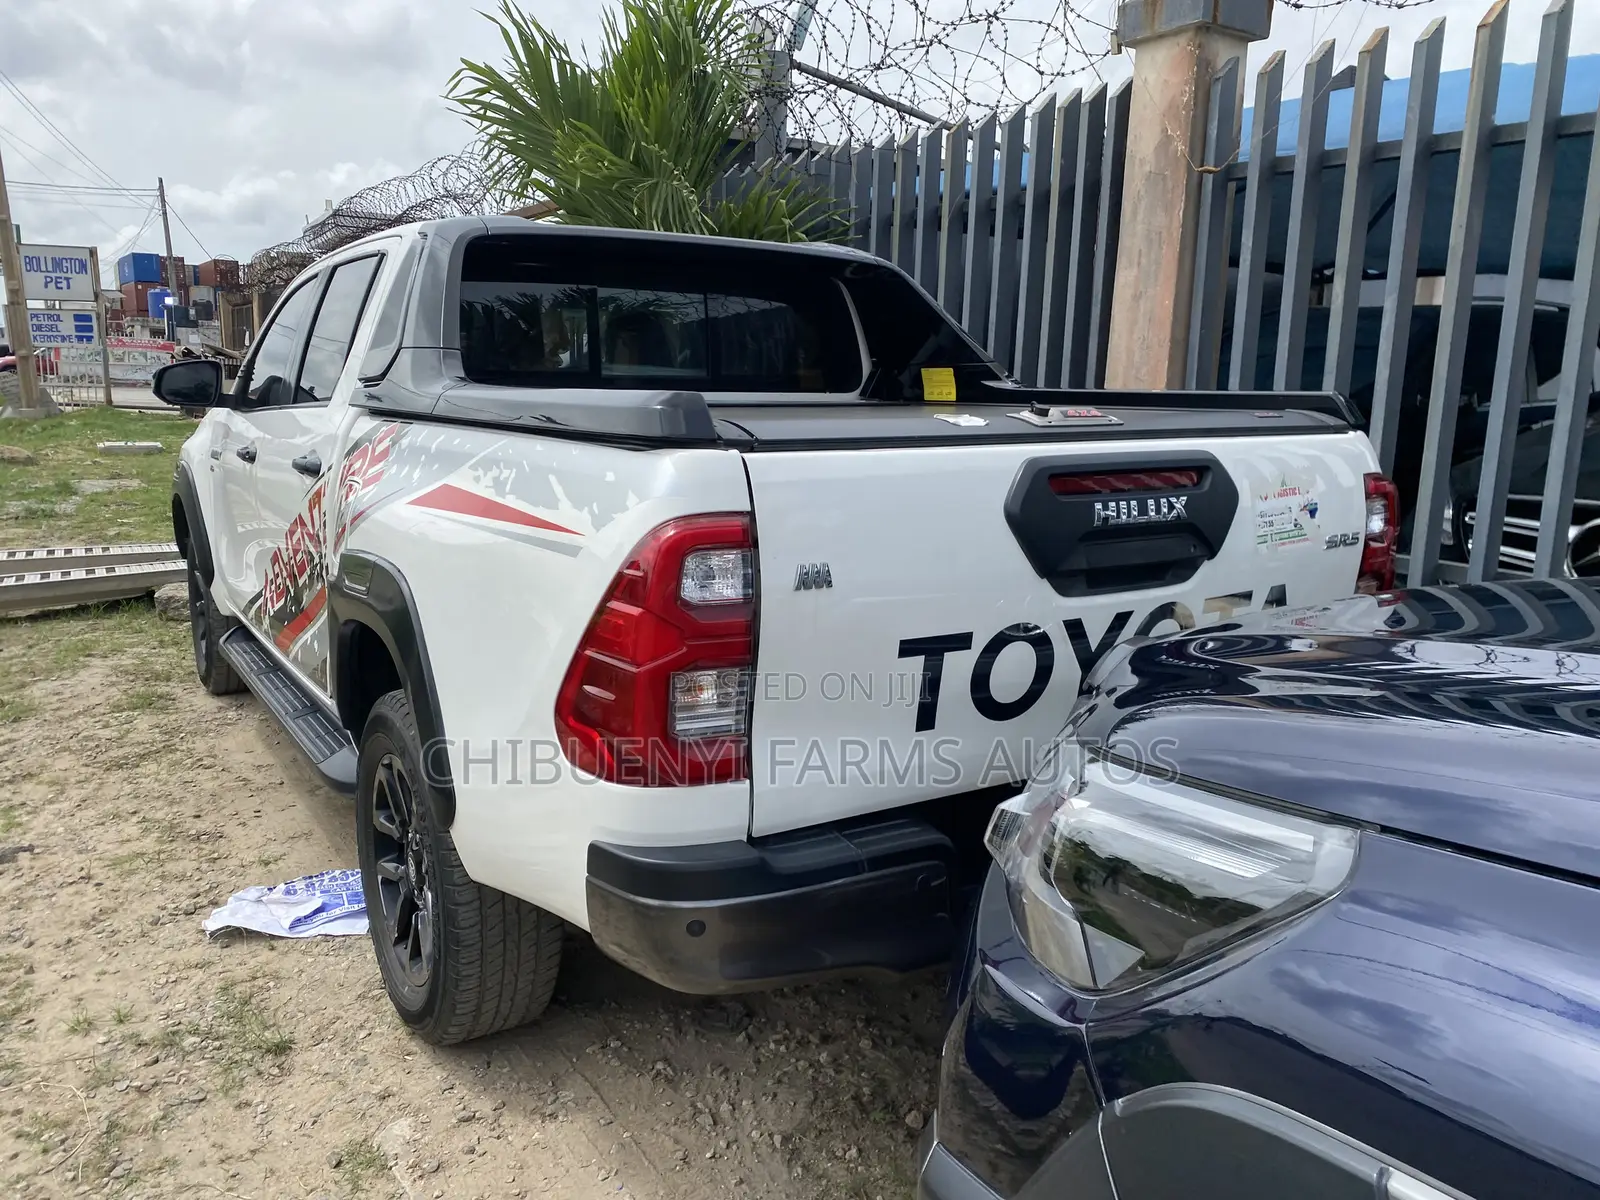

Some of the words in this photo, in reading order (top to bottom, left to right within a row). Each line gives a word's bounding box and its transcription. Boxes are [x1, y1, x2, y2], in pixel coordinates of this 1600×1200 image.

[23, 255, 88, 275] BOLLINGTON
[43, 275, 73, 290] PET
[30, 312, 63, 322] PETROL
[31, 323, 61, 333] DIESEL
[1094, 496, 1188, 526] HILUX
[1322, 532, 1361, 551] SR5
